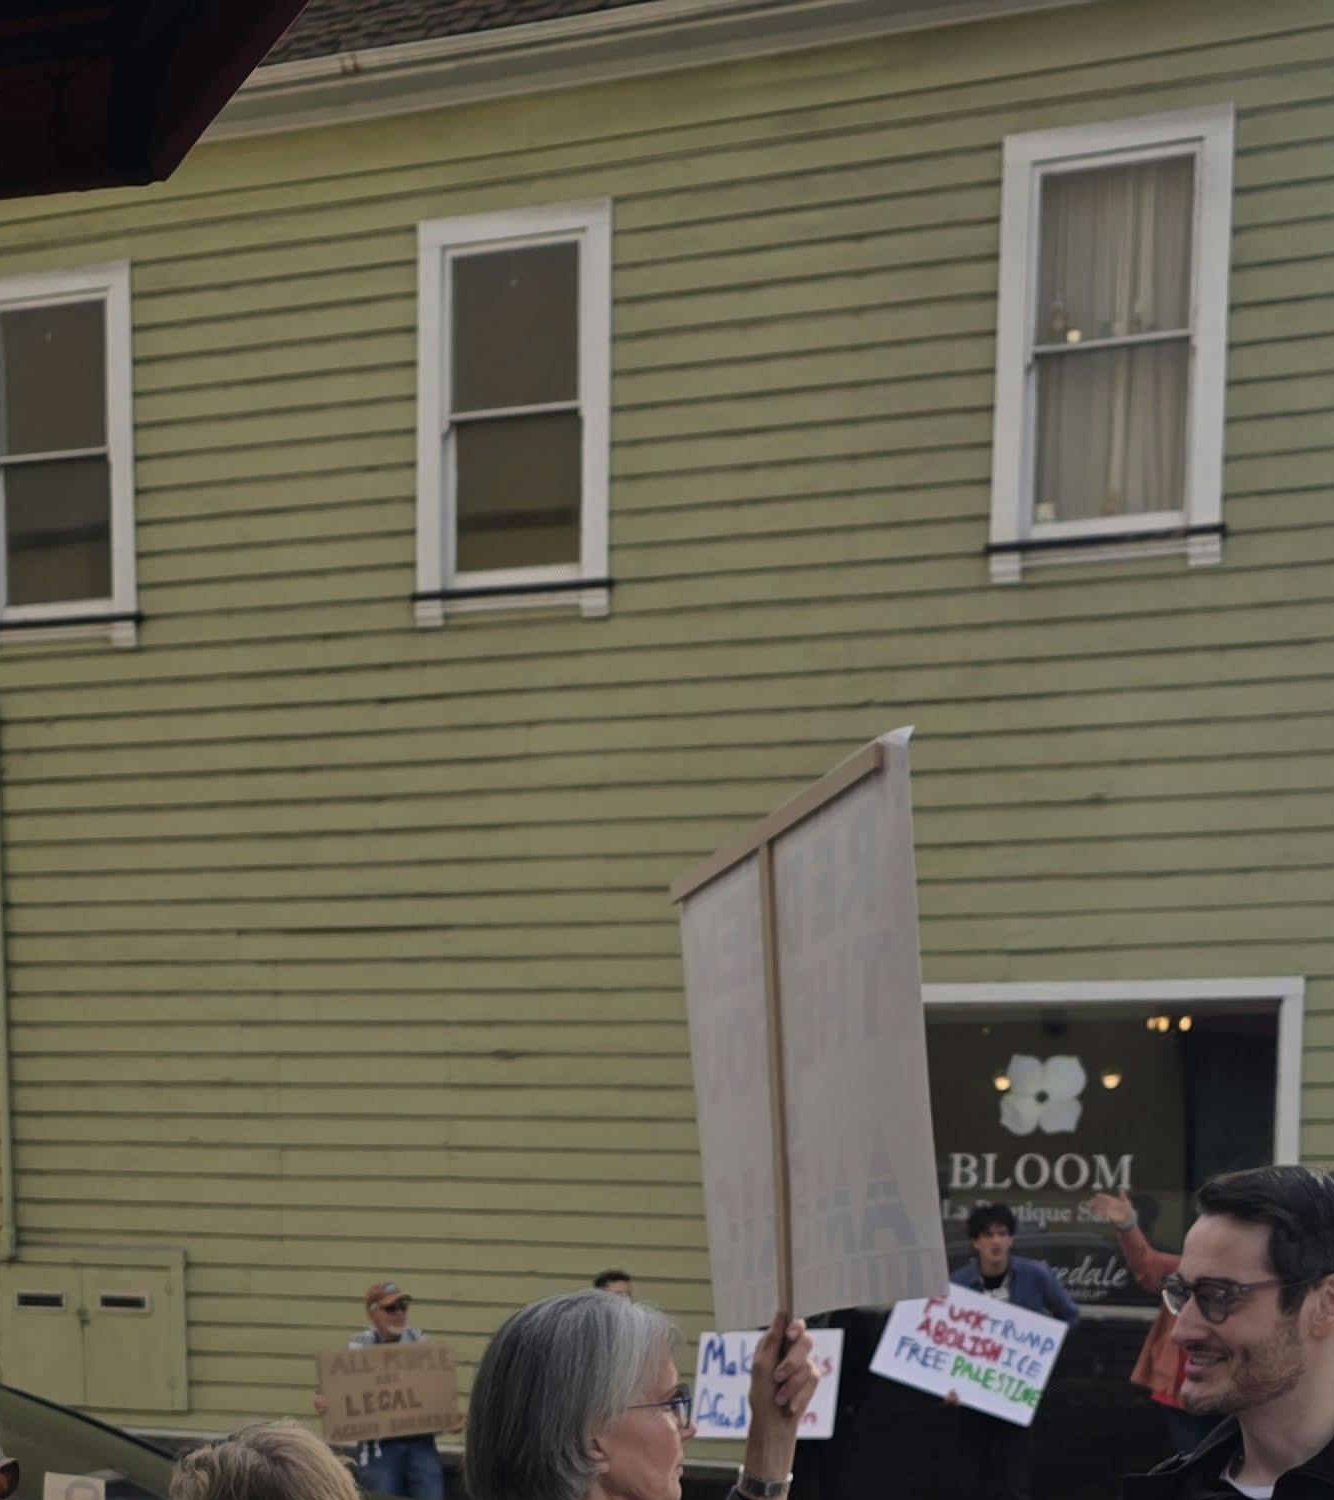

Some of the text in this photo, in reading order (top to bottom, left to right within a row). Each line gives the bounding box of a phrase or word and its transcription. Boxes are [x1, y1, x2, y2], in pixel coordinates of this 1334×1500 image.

[949, 1152, 1134, 1190] BLOOM
[701, 1335, 753, 1376] Mak
[915, 1316, 1043, 1378] ABOLISH ICE
[988, 1317, 1056, 1356] TRUMP
[330, 1352, 375, 1376] ALL
[893, 1335, 1044, 1409] FREE PALESTINE
[345, 1387, 422, 1417] LEGAL
